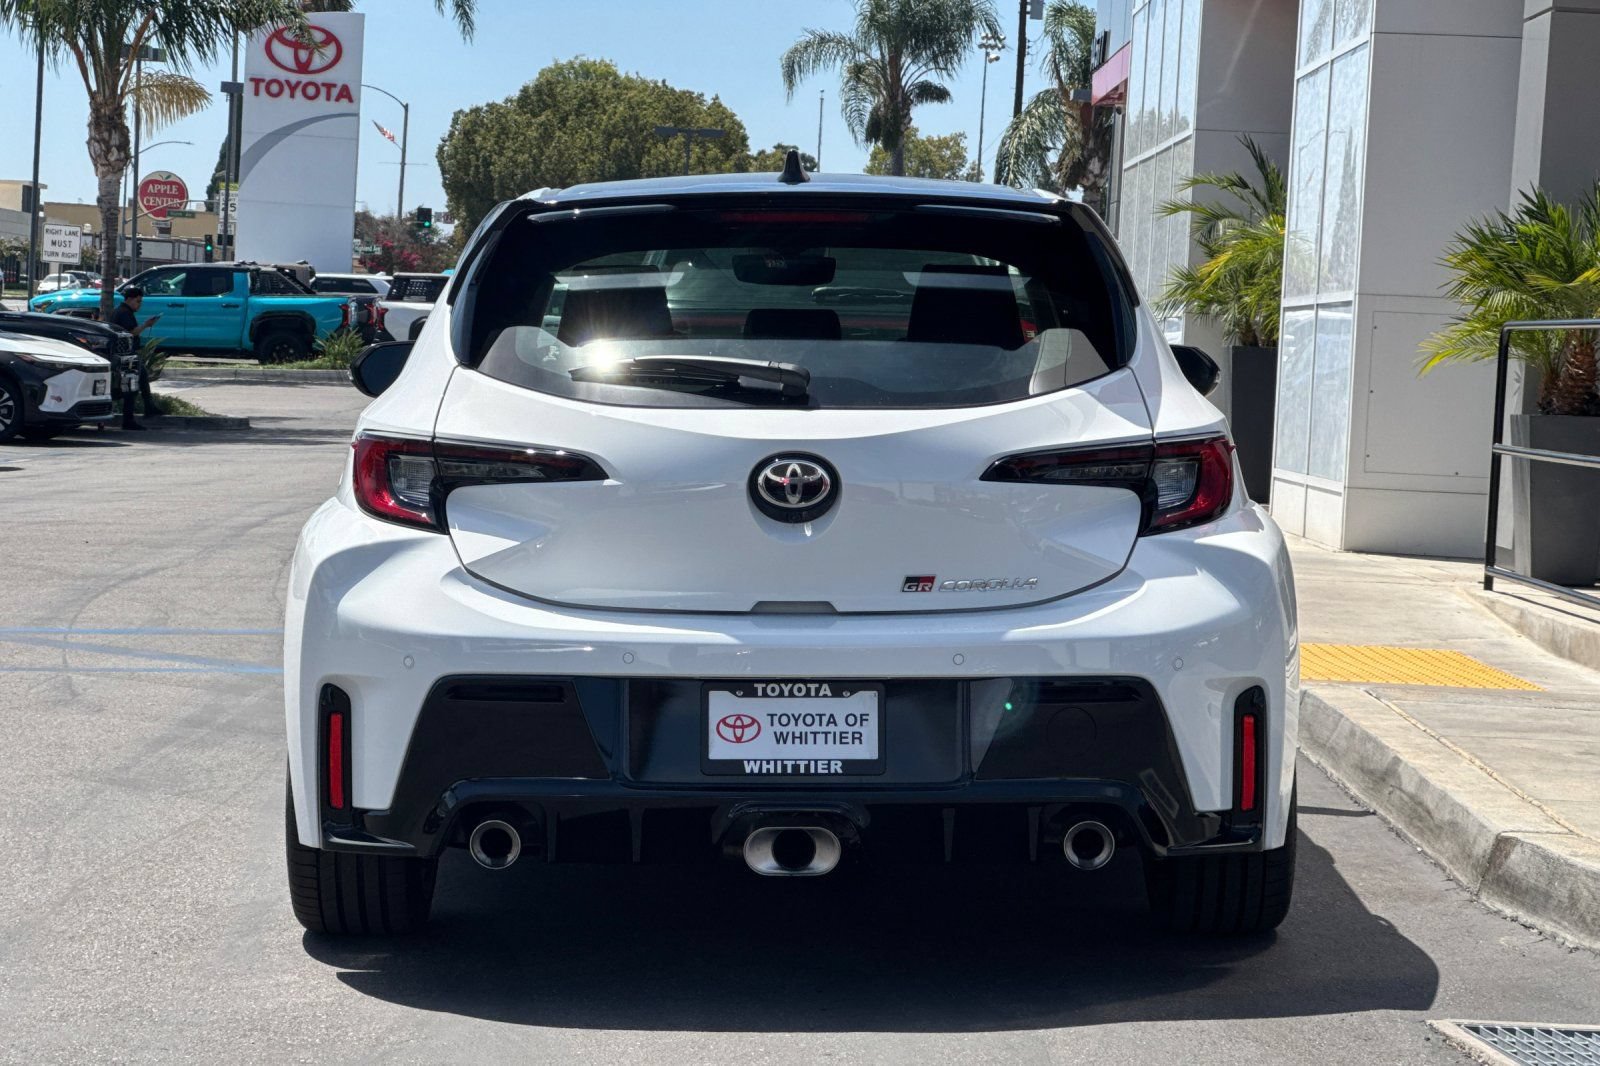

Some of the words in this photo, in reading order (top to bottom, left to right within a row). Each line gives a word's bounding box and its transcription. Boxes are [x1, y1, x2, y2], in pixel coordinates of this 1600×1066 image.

[249, 77, 354, 103] TOYOTA
[147, 184, 179, 195] APPLE
[143, 196, 181, 208] CENTER
[64, 229, 79, 237] LANE
[51, 240, 72, 248] MUST
[61, 251, 78, 259] RIGHT
[903, 582, 932, 592] GR
[753, 683, 832, 697] TOYOTA
[766, 713, 838, 727] TOYOTA
[844, 713, 870, 727] OF
[773, 731, 863, 745] WHITTIER
[743, 760, 843, 774] WHITTIER
